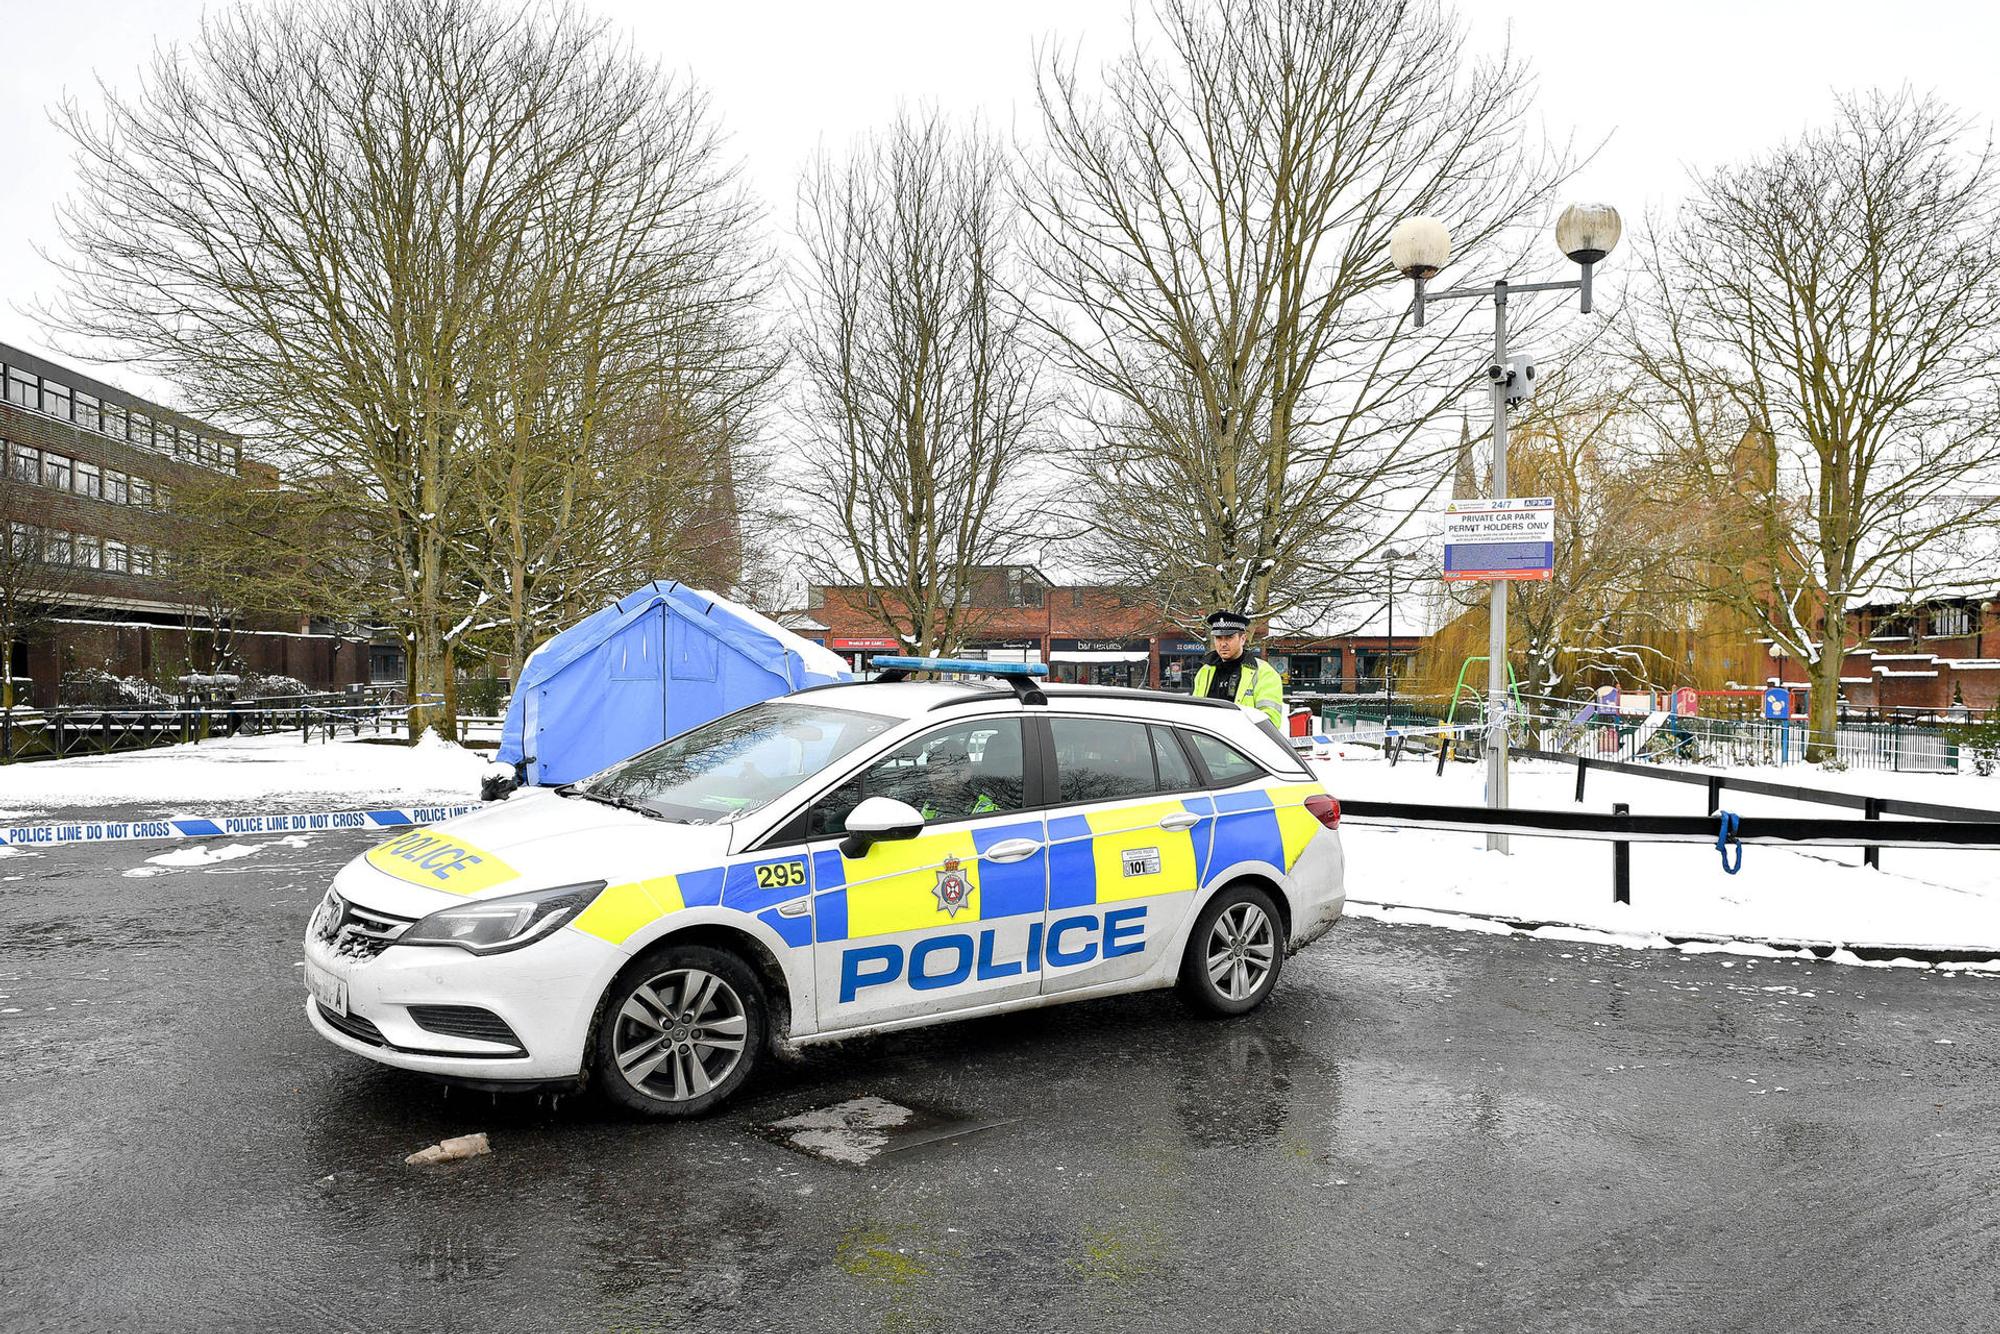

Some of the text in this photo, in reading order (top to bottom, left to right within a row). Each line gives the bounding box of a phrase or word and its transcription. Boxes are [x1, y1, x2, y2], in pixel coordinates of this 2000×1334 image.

[1491, 501, 1512, 509] 24/7
[1514, 512, 1536, 520] PARK
[1448, 522, 1549, 532] PERMIT HOLDERS ONLY
[226, 812, 365, 832] POLICE LINE DO NOT CROSS
[413, 807, 446, 822] POLICE
[10, 822, 170, 843] POLICE LINE DO NOT CROSS
[378, 833, 482, 880] POLICE
[758, 862, 804, 888] 295
[1130, 860, 1145, 874] 101
[839, 905, 1147, 1004] POLICE
